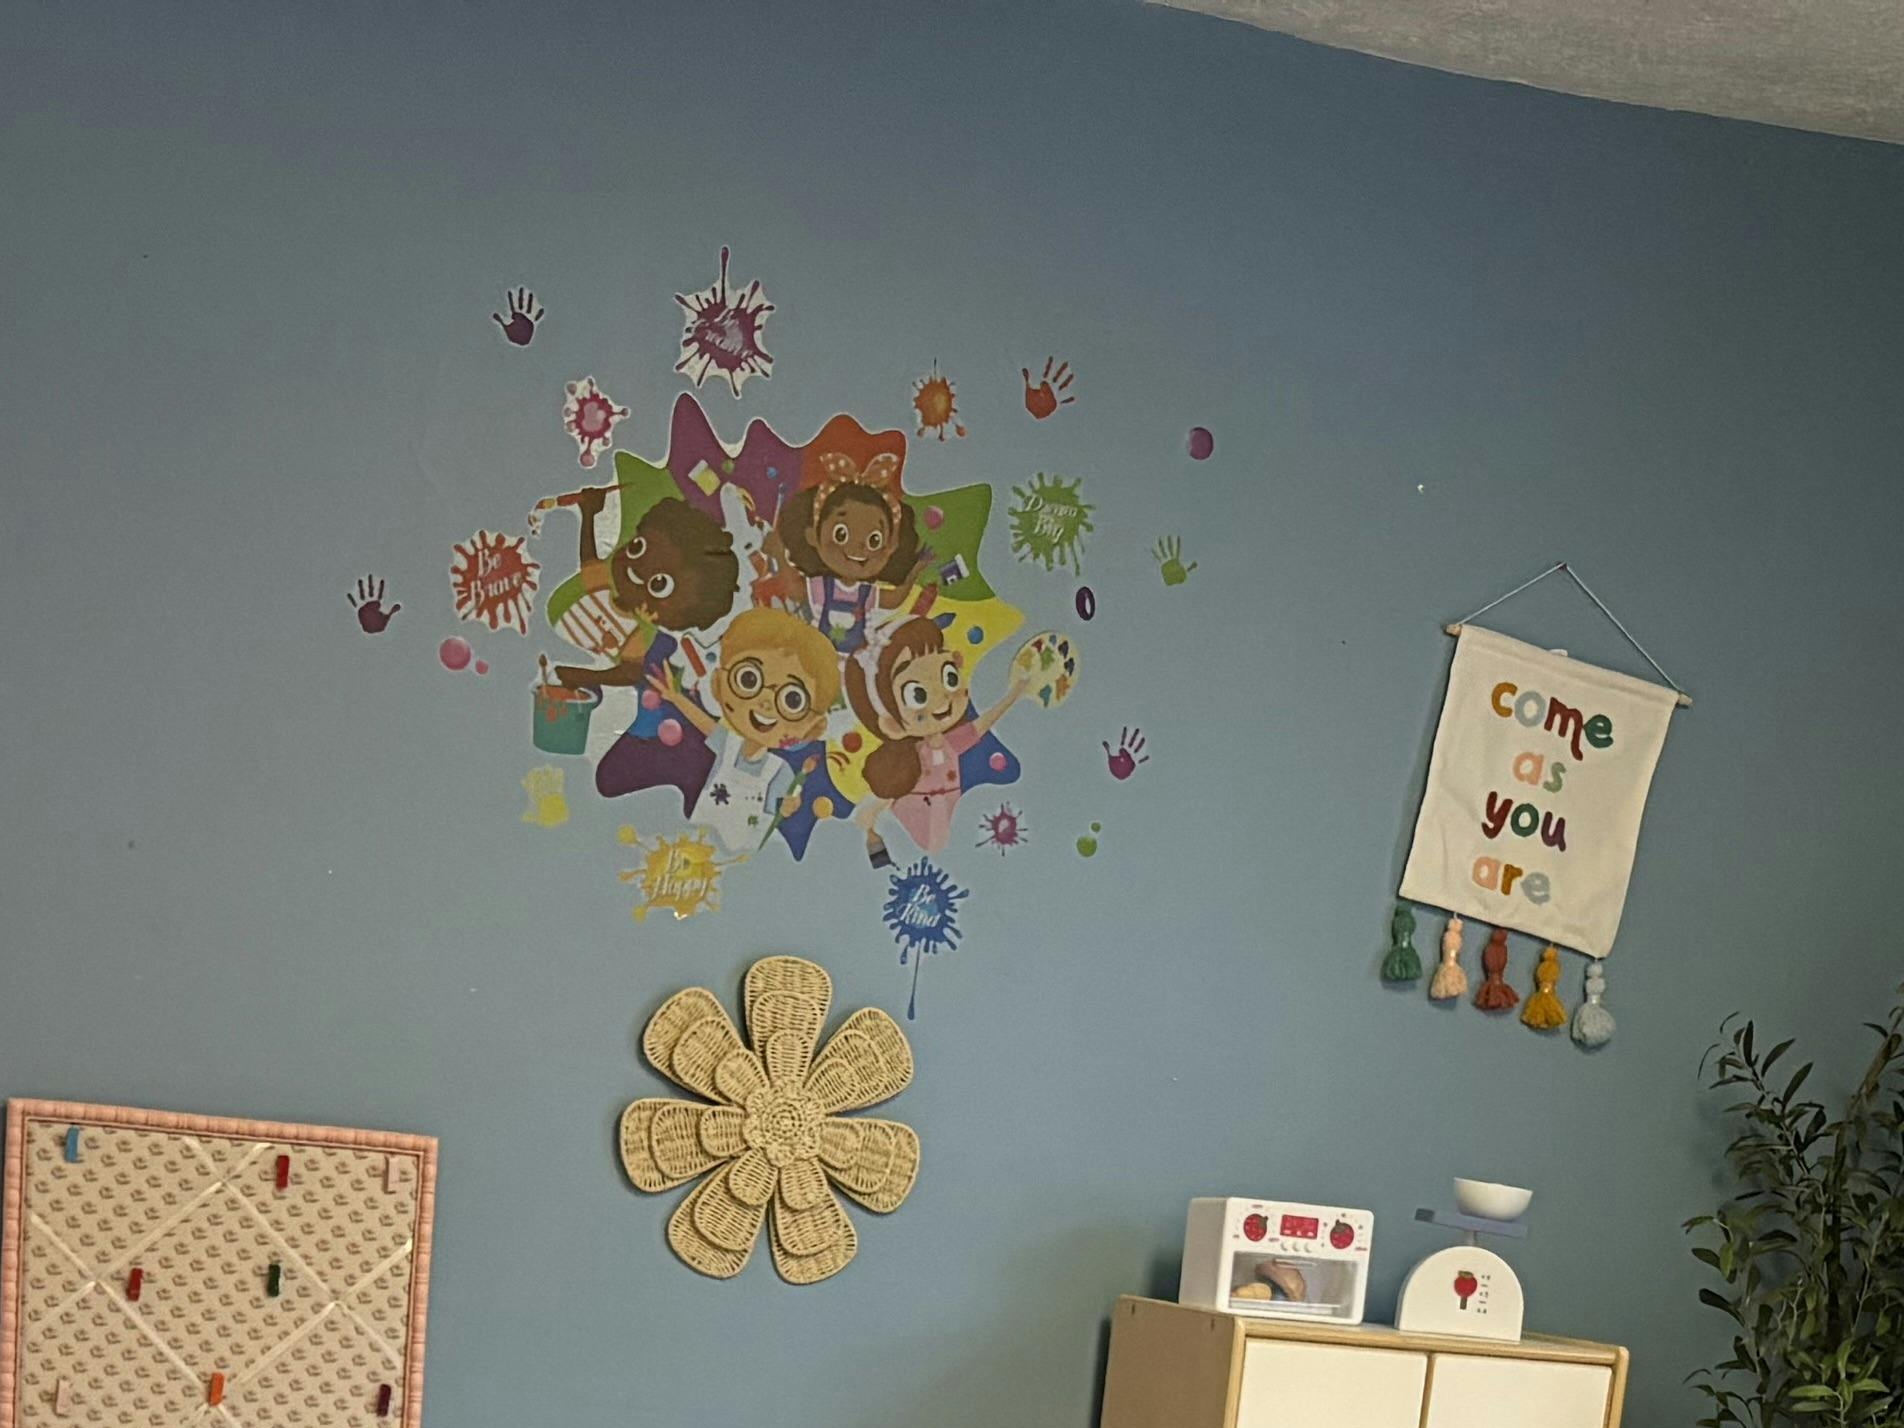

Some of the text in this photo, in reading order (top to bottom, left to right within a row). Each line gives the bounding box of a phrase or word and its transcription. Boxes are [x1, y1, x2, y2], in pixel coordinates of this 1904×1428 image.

[478, 548, 502, 578] Be
[470, 572, 523, 608] Brave
[1490, 681, 1615, 761] come
[1512, 749, 1567, 793] as
[1481, 791, 1567, 852] you
[912, 884, 936, 905] Be
[1472, 856, 1552, 905] are
[897, 902, 942, 928] Kind
